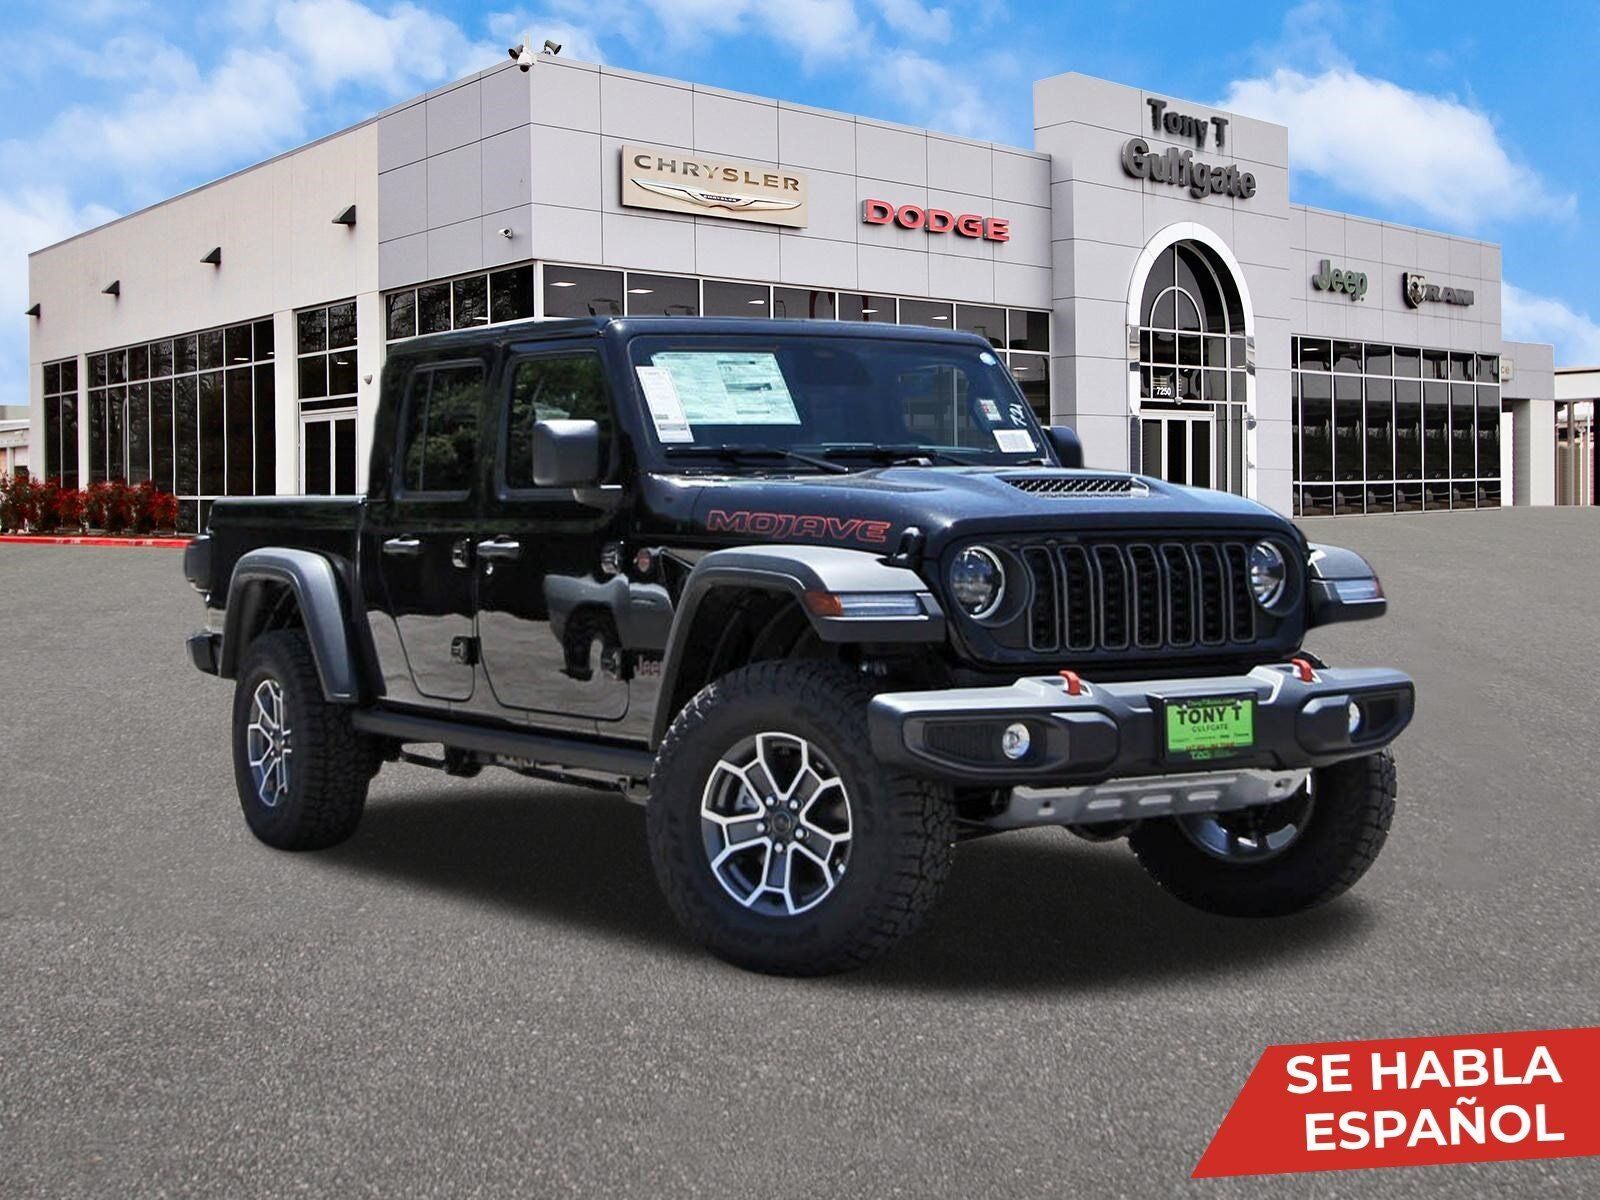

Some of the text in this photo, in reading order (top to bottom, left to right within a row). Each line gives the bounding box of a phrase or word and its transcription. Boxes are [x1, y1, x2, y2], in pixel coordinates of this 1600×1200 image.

[1147, 97, 1229, 148] Tony T
[633, 153, 801, 192] CHRYSLER
[1121, 137, 1257, 199] Gulfgate
[862, 198, 1011, 243] DODGE
[1312, 259, 1368, 302] Jeep
[1424, 283, 1475, 306] RAM
[706, 509, 891, 543] MOJAVE
[1176, 704, 1242, 725] TONY T
